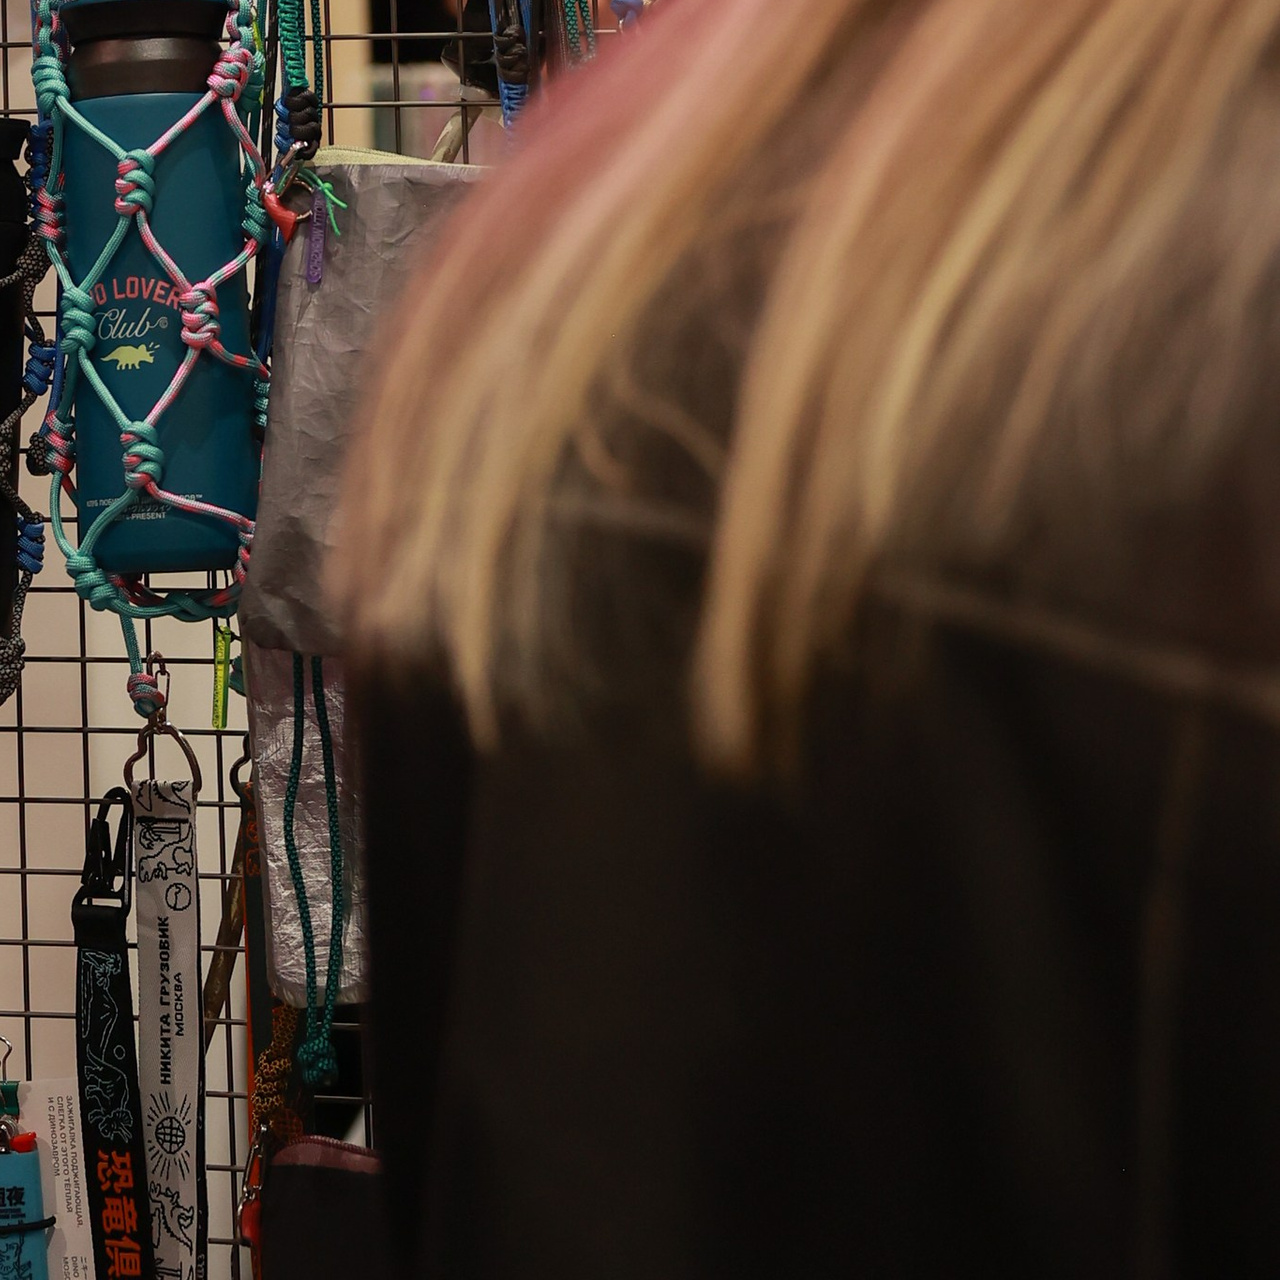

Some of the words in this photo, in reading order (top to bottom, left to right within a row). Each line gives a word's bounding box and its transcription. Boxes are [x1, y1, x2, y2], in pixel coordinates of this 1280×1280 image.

[113, 276, 182, 312] LOVER
[95, 307, 168, 340] Club
[158, 916, 171, 1006] ГРУЗОВИК
[174, 972, 184, 1036] МОСКВА
[160, 1013, 171, 1085] НИКИТА
[57, 1096, 65, 1134] СЛЕГКА
[60, 1135, 67, 1144] ОТ
[49, 1112, 61, 1177] ДИНОЗАВРОМ
[66, 1095, 76, 1150] ЗАЖИГАЛКА
[71, 1152, 83, 1228] ПОДЖИГАЮЩАЯ.
[71, 1256, 80, 1278] DINO
